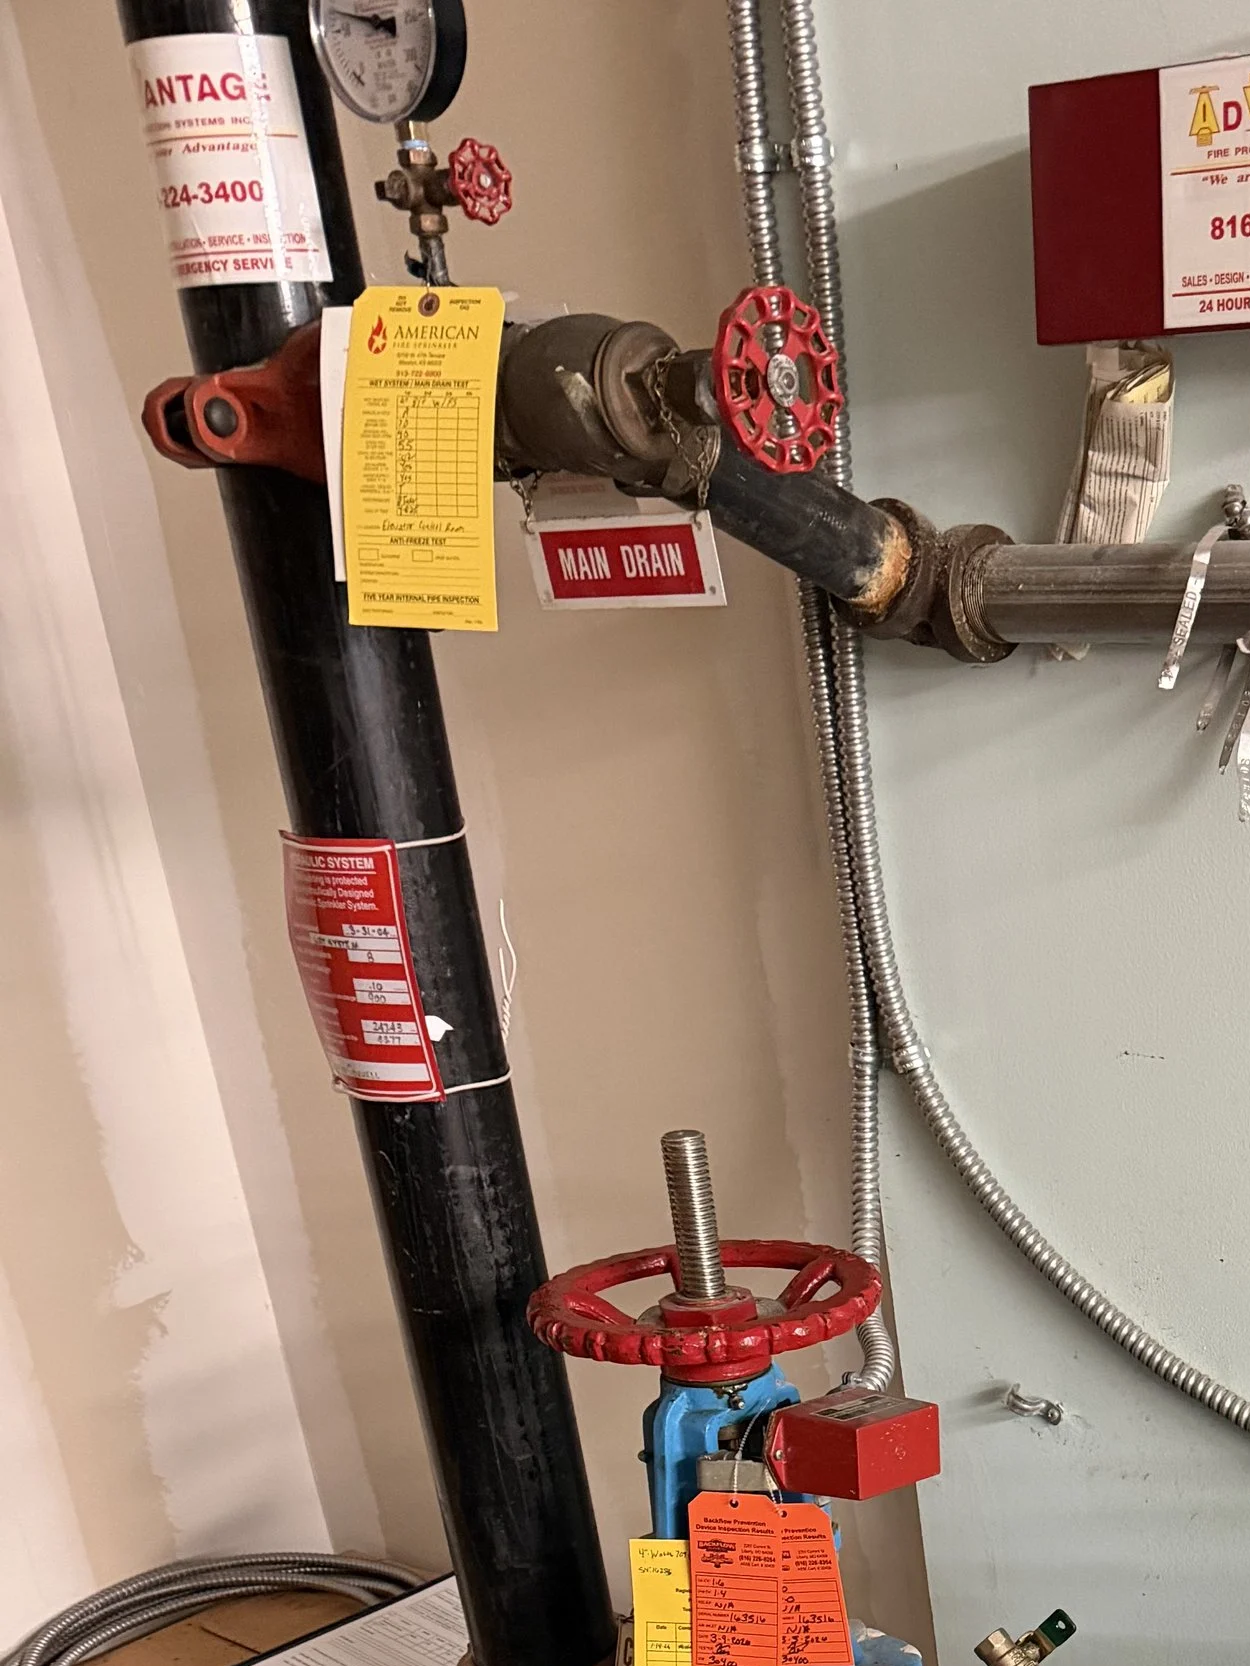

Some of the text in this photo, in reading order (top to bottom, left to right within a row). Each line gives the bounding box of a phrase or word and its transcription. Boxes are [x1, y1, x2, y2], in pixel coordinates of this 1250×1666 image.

[174, 116, 226, 129] SYSTEMS
[1206, 148, 1230, 160] FIRE
[233, 256, 293, 271] SERVIE
[1181, 274, 1208, 288] SALES
[1214, 270, 1245, 286] DESIGN
[1198, 300, 1214, 313] 24
[1216, 296, 1250, 312] HOUR
[393, 325, 480, 340] AMERICAN
[369, 380, 383, 388] WET
[383, 380, 410, 388] SYSTEM
[414, 380, 431, 388] MAIN
[431, 380, 451, 388] DRAIN
[453, 380, 469, 388] TEST
[389, 537, 429, 545] ANTI-FREEZE
[557, 543, 686, 581] MAIN DRAIN
[363, 592, 480, 604] FIVE YEAR INTERNAL PIPE INSPECTION
[327, 856, 375, 870] SYSTEM
[337, 888, 375, 899] Designed
[703, 1516, 767, 1527] Backflow Prevention
[695, 1523, 775, 1535] Device Inspection Results
